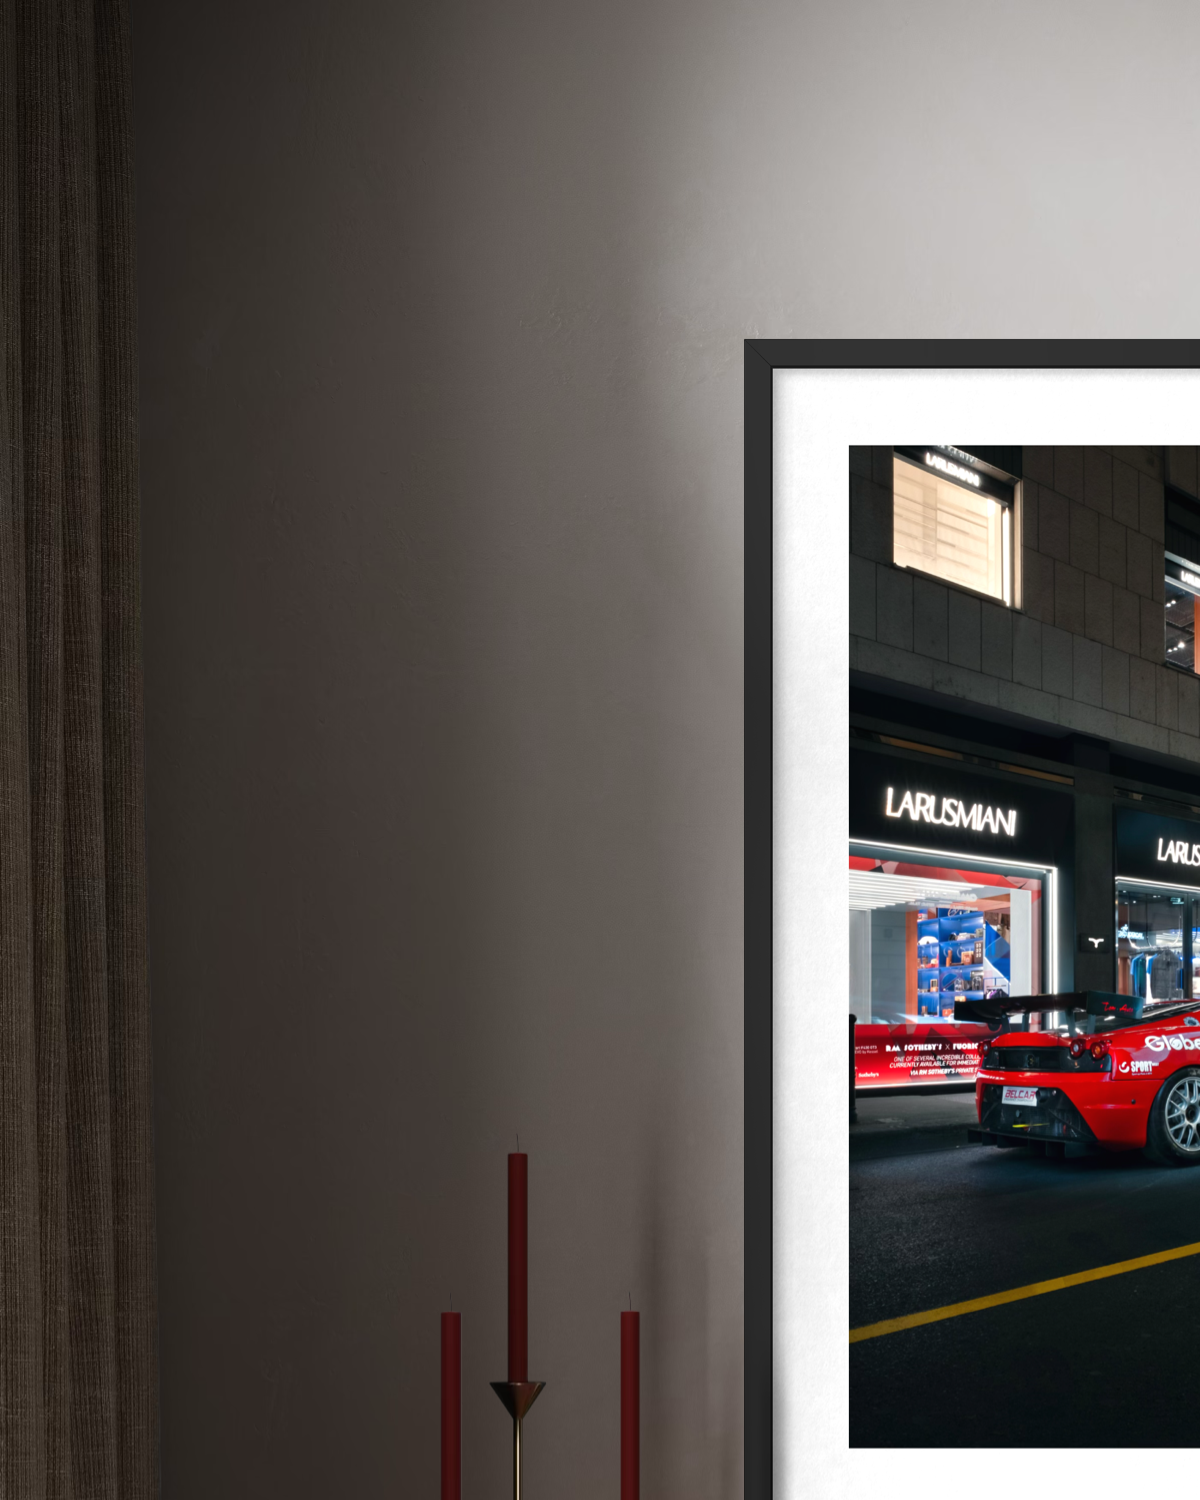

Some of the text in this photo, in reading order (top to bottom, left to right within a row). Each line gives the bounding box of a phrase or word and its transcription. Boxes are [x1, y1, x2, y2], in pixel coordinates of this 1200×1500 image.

[886, 787, 1017, 837] LARUSMIANI
[1131, 1060, 1153, 1073] SPORT
[1004, 1089, 1037, 1100] BELCAR
